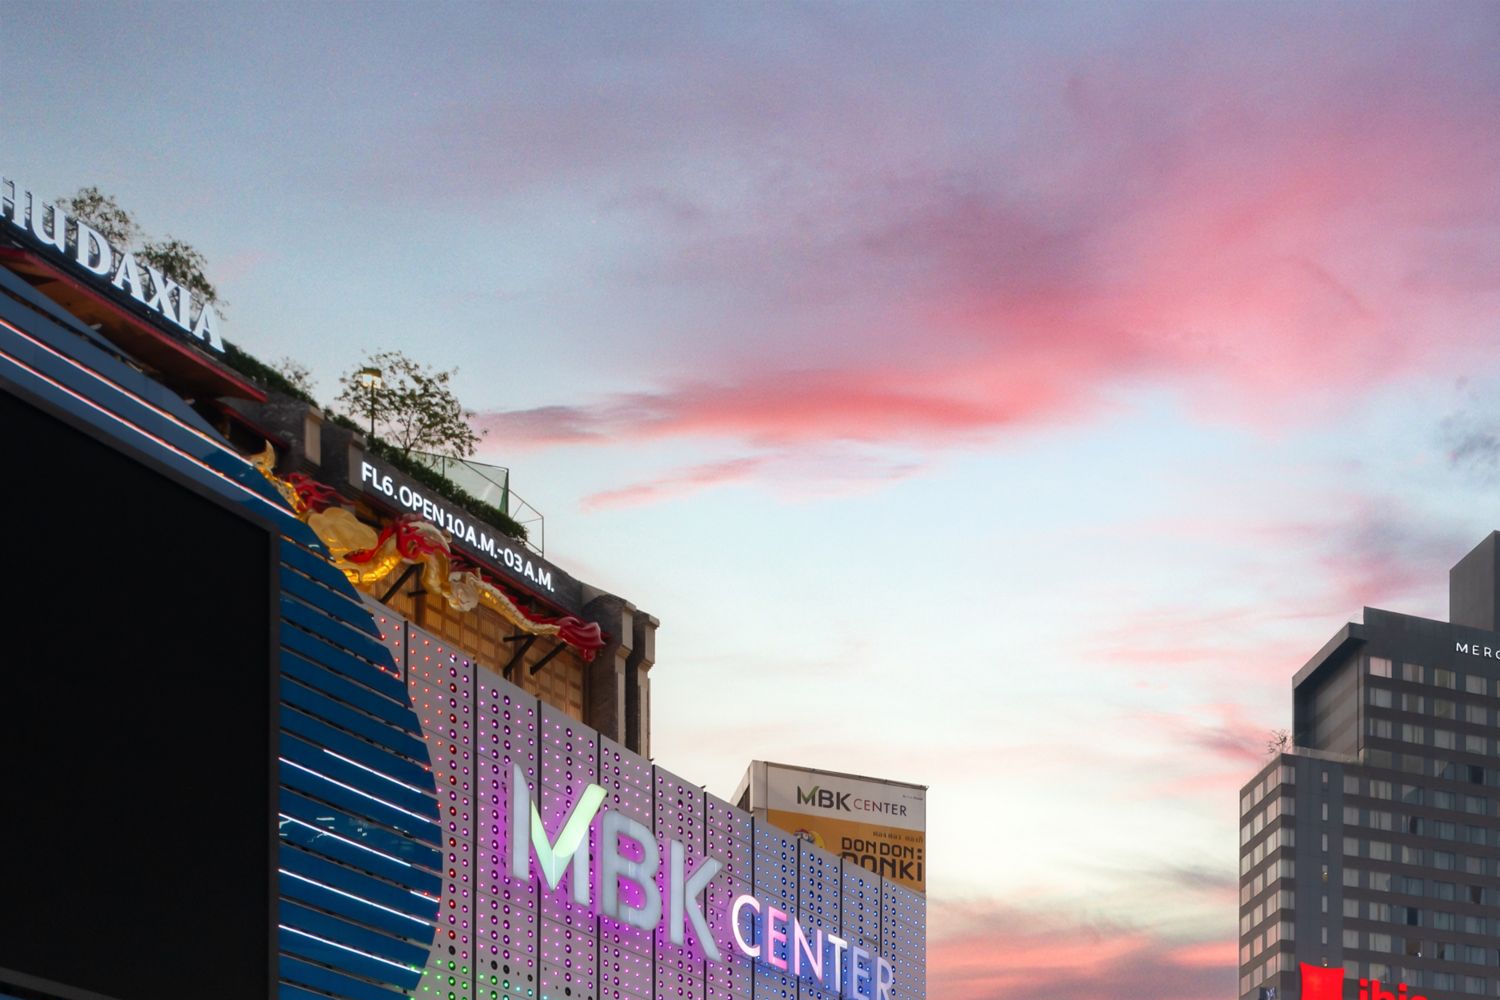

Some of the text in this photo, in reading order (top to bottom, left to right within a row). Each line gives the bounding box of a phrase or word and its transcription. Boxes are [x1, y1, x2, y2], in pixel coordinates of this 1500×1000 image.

[797, 785, 907, 817] MBK CENTER
[510, 763, 724, 962] MBK
[841, 836, 877, 854] DON
[880, 842, 914, 859] DON
